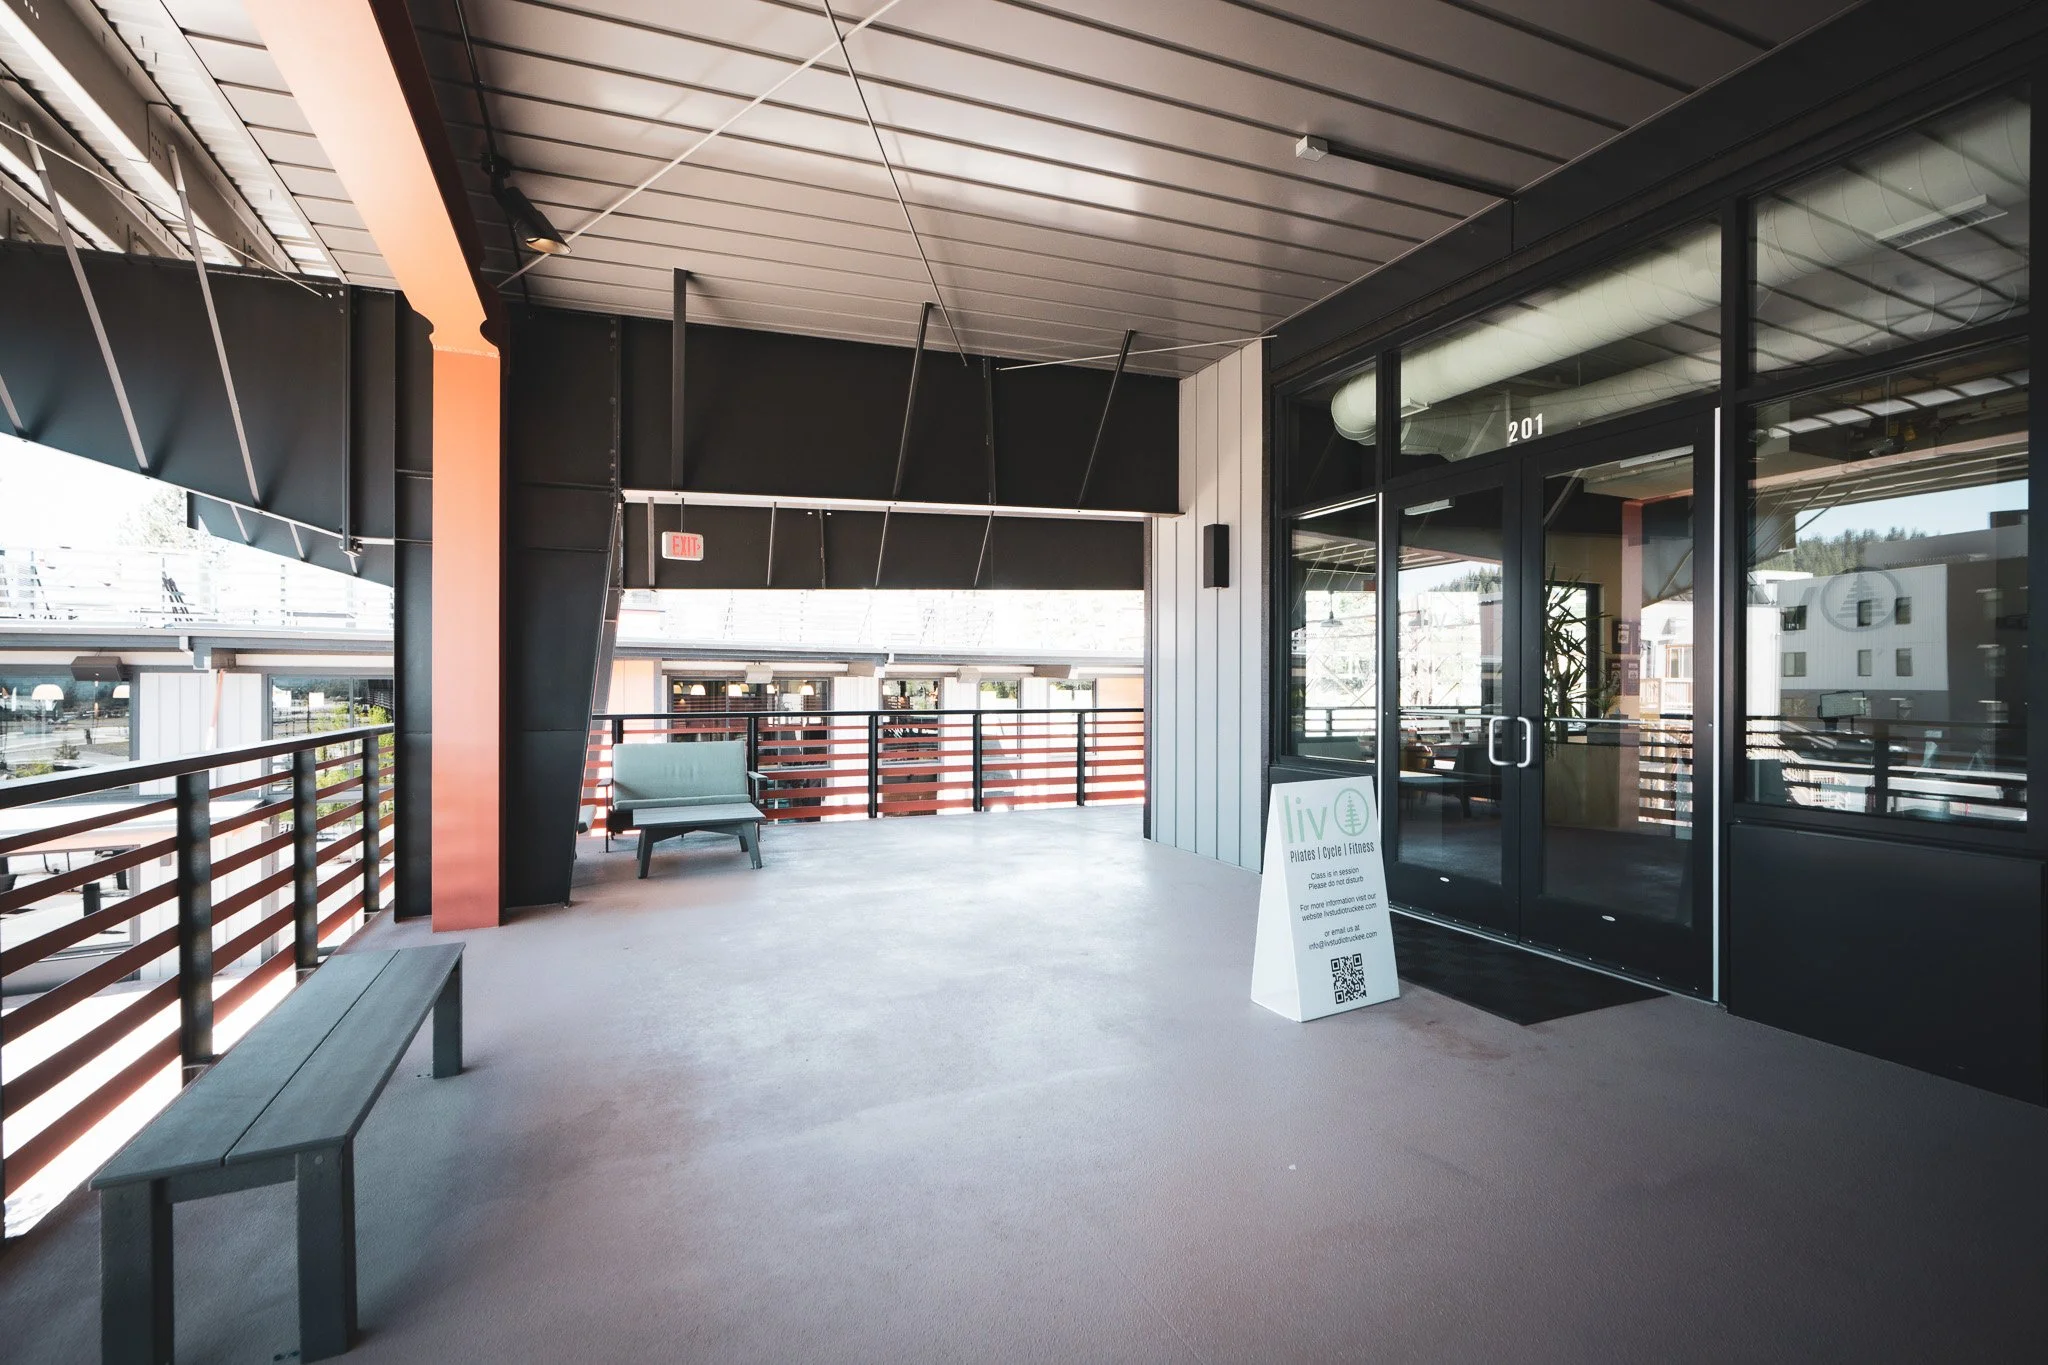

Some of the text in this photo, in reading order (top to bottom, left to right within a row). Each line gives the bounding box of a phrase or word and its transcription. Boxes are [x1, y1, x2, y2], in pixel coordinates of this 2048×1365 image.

[1508, 412, 1543, 444] 201
[671, 535, 698, 557] EXIT
[1284, 795, 1328, 843] liv
[1290, 849, 1316, 863] Pilates
[1322, 844, 1342, 860] Cycle
[1349, 841, 1375, 855] Fitness
[1310, 867, 1359, 880] Class is in session
[1308, 875, 1364, 891] Please do not disturb
[1299, 904, 1310, 912] For
[1311, 901, 1325, 909] more
[1325, 896, 1356, 907] information
[1356, 894, 1367, 902] visit
[1301, 911, 1323, 922] website
[1331, 926, 1346, 935] email
[1346, 925, 1354, 933] us
